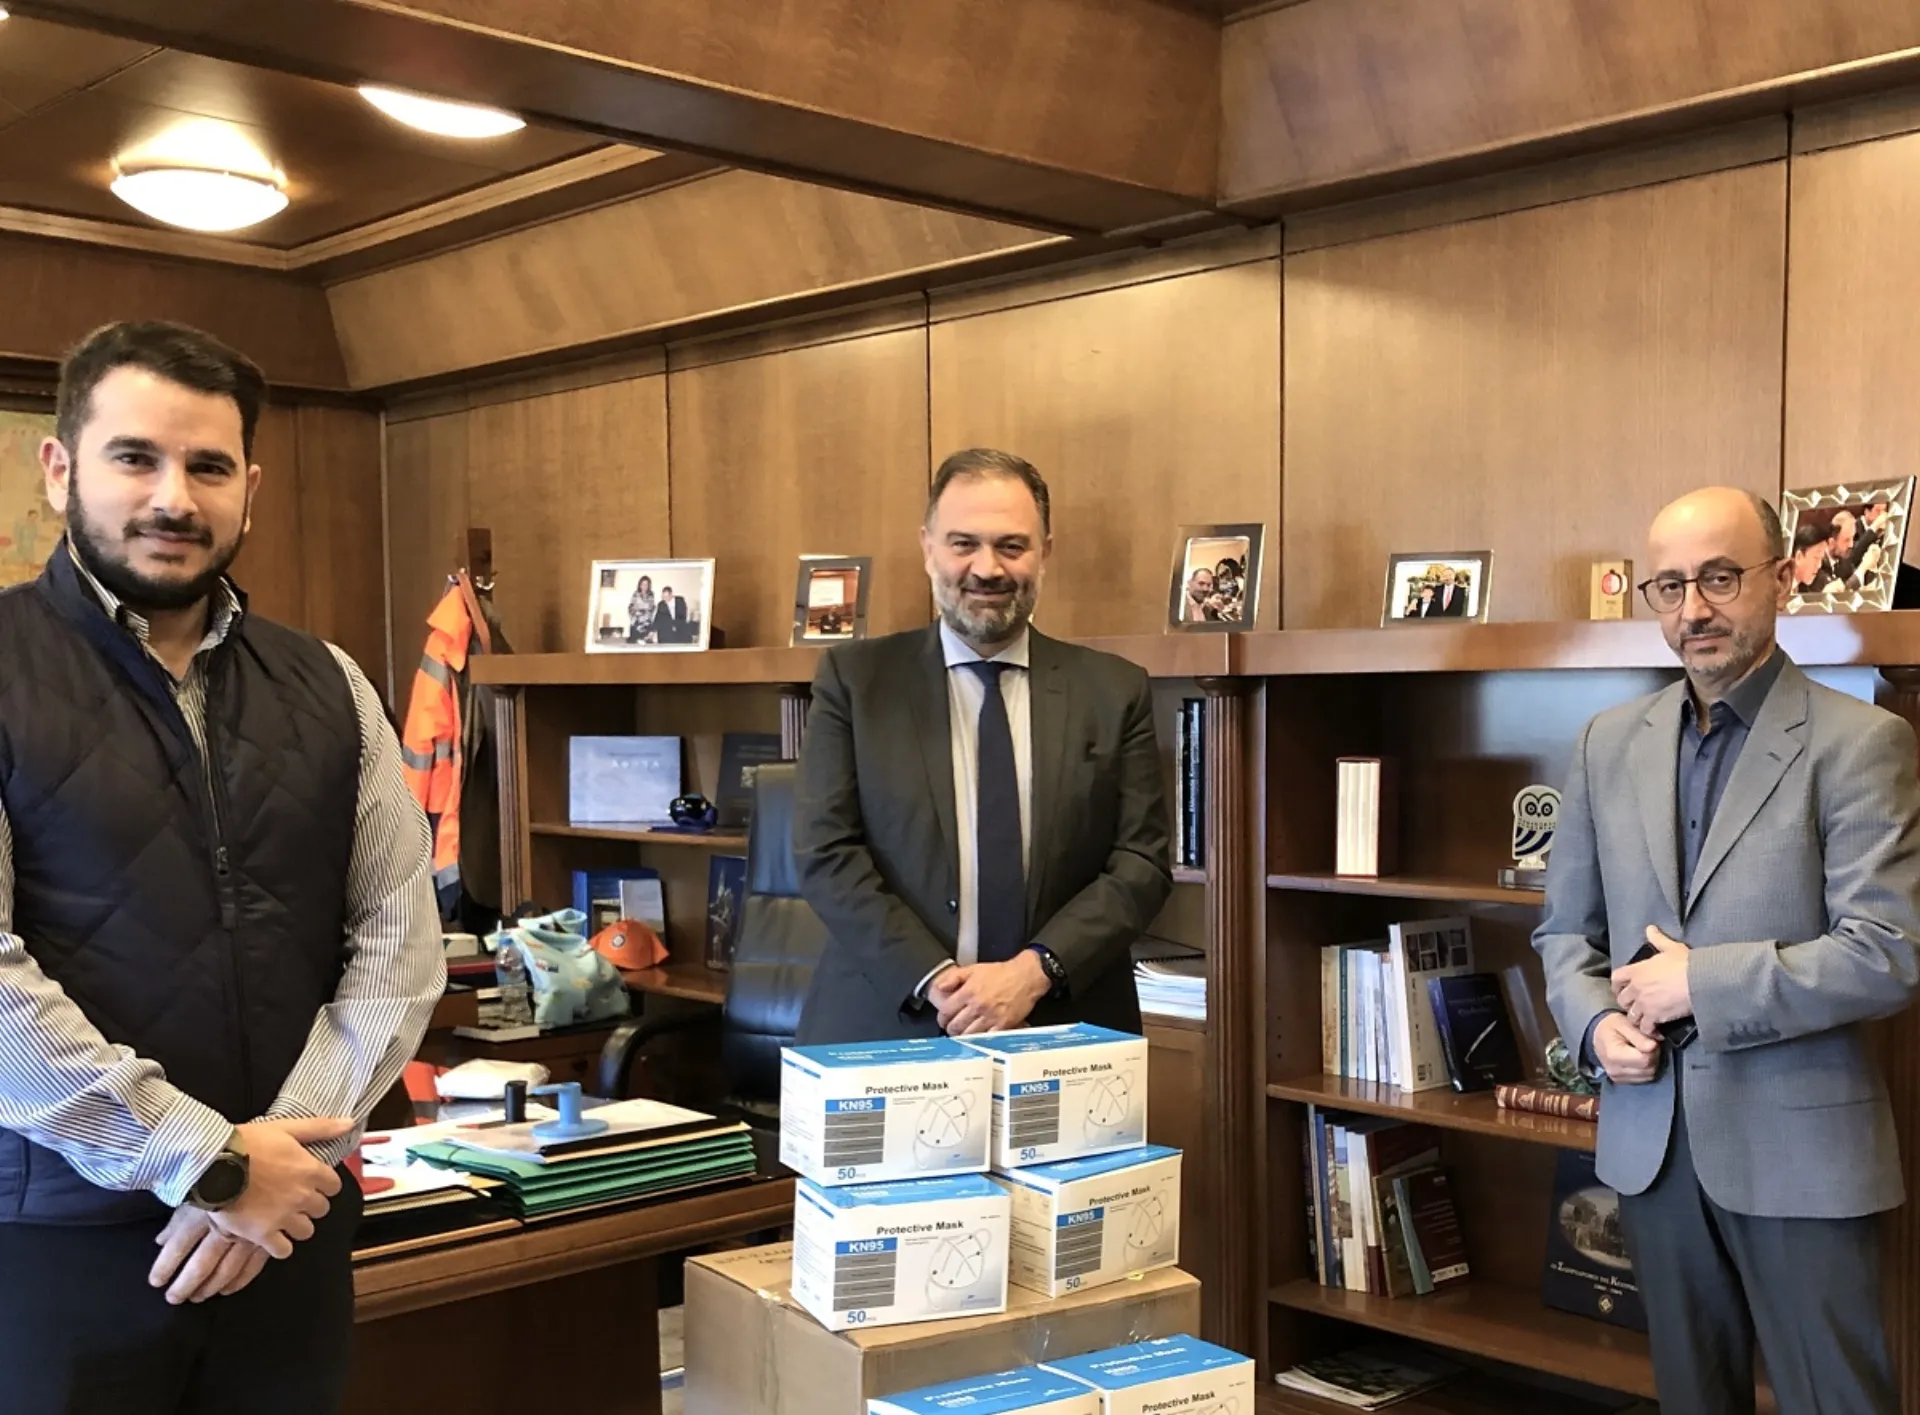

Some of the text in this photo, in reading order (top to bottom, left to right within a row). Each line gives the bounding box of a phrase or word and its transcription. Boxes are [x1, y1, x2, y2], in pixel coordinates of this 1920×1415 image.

[1042, 1062, 1113, 1078] Protective Mask
[865, 1081, 949, 1095] Protective Mask
[1020, 1082, 1051, 1094] KN95
[838, 1099, 874, 1111] KN95
[1020, 1147, 1036, 1160] 50
[837, 1167, 856, 1180] 50
[1088, 1185, 1151, 1206] Protective Mask
[876, 1220, 964, 1236] Protective Mask
[848, 1241, 885, 1253] KN95
[1065, 1277, 1081, 1290] 50
[847, 1310, 866, 1324] 50
[1142, 1390, 1216, 1414] Protective Mask
